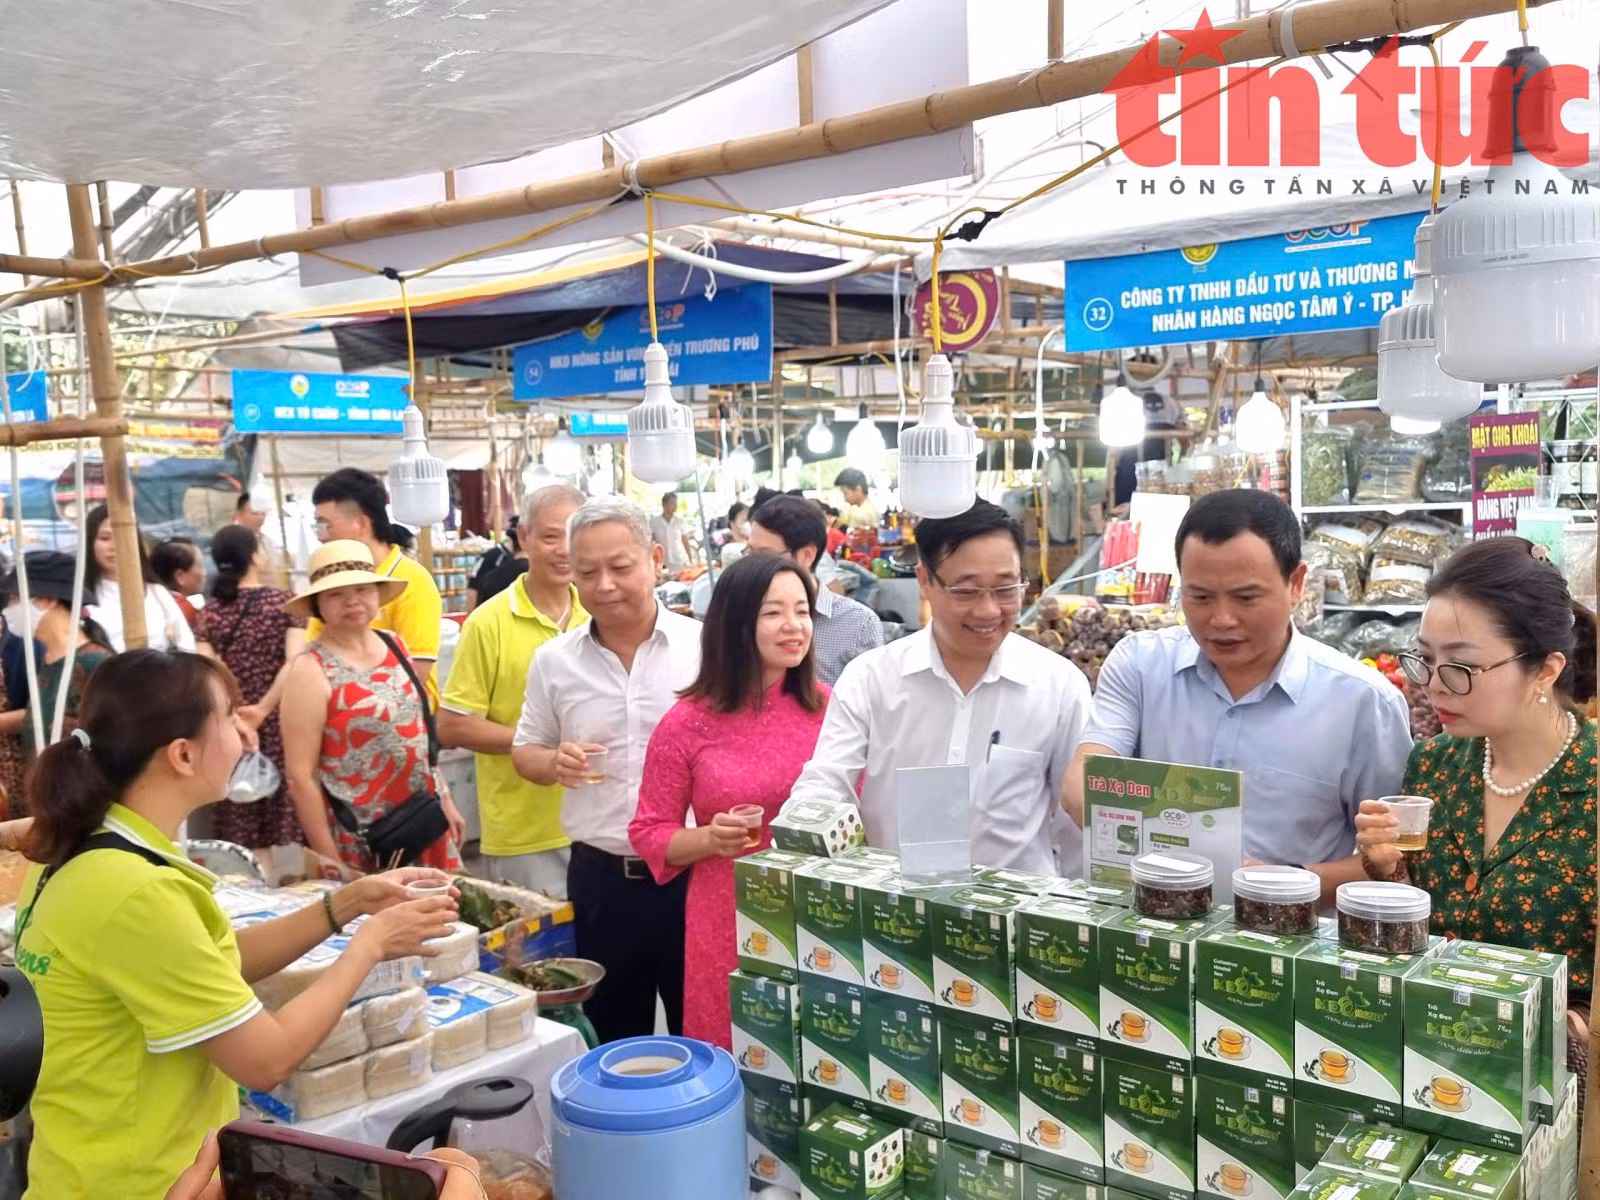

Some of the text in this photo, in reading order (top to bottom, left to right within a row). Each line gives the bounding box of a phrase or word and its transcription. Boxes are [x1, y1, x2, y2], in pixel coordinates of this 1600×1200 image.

[1121, 286, 1162, 309] CÔNG
[1167, 286, 1184, 304] TY
[1190, 280, 1231, 303] TNHH
[1273, 271, 1295, 293] TƯ
[1299, 267, 1322, 289] VÀ
[1326, 261, 1398, 286] THƯƠNG
[1089, 307, 1106, 321] 32
[1200, 304, 1245, 328] HÀNG
[1249, 302, 1295, 326] NGỌC
[1300, 294, 1337, 319] TÂM
[1342, 290, 1354, 314] Ý
[1371, 291, 1396, 312] TP.
[1472, 419, 1538, 453] MẬT ONG KHOÁI
[1477, 494, 1499, 521] HÀNG
[1500, 493, 1517, 523] VIỆT
[1088, 776, 1106, 792] Trà
[1108, 777, 1124, 797] Xạ
[1127, 780, 1150, 797] Đen
